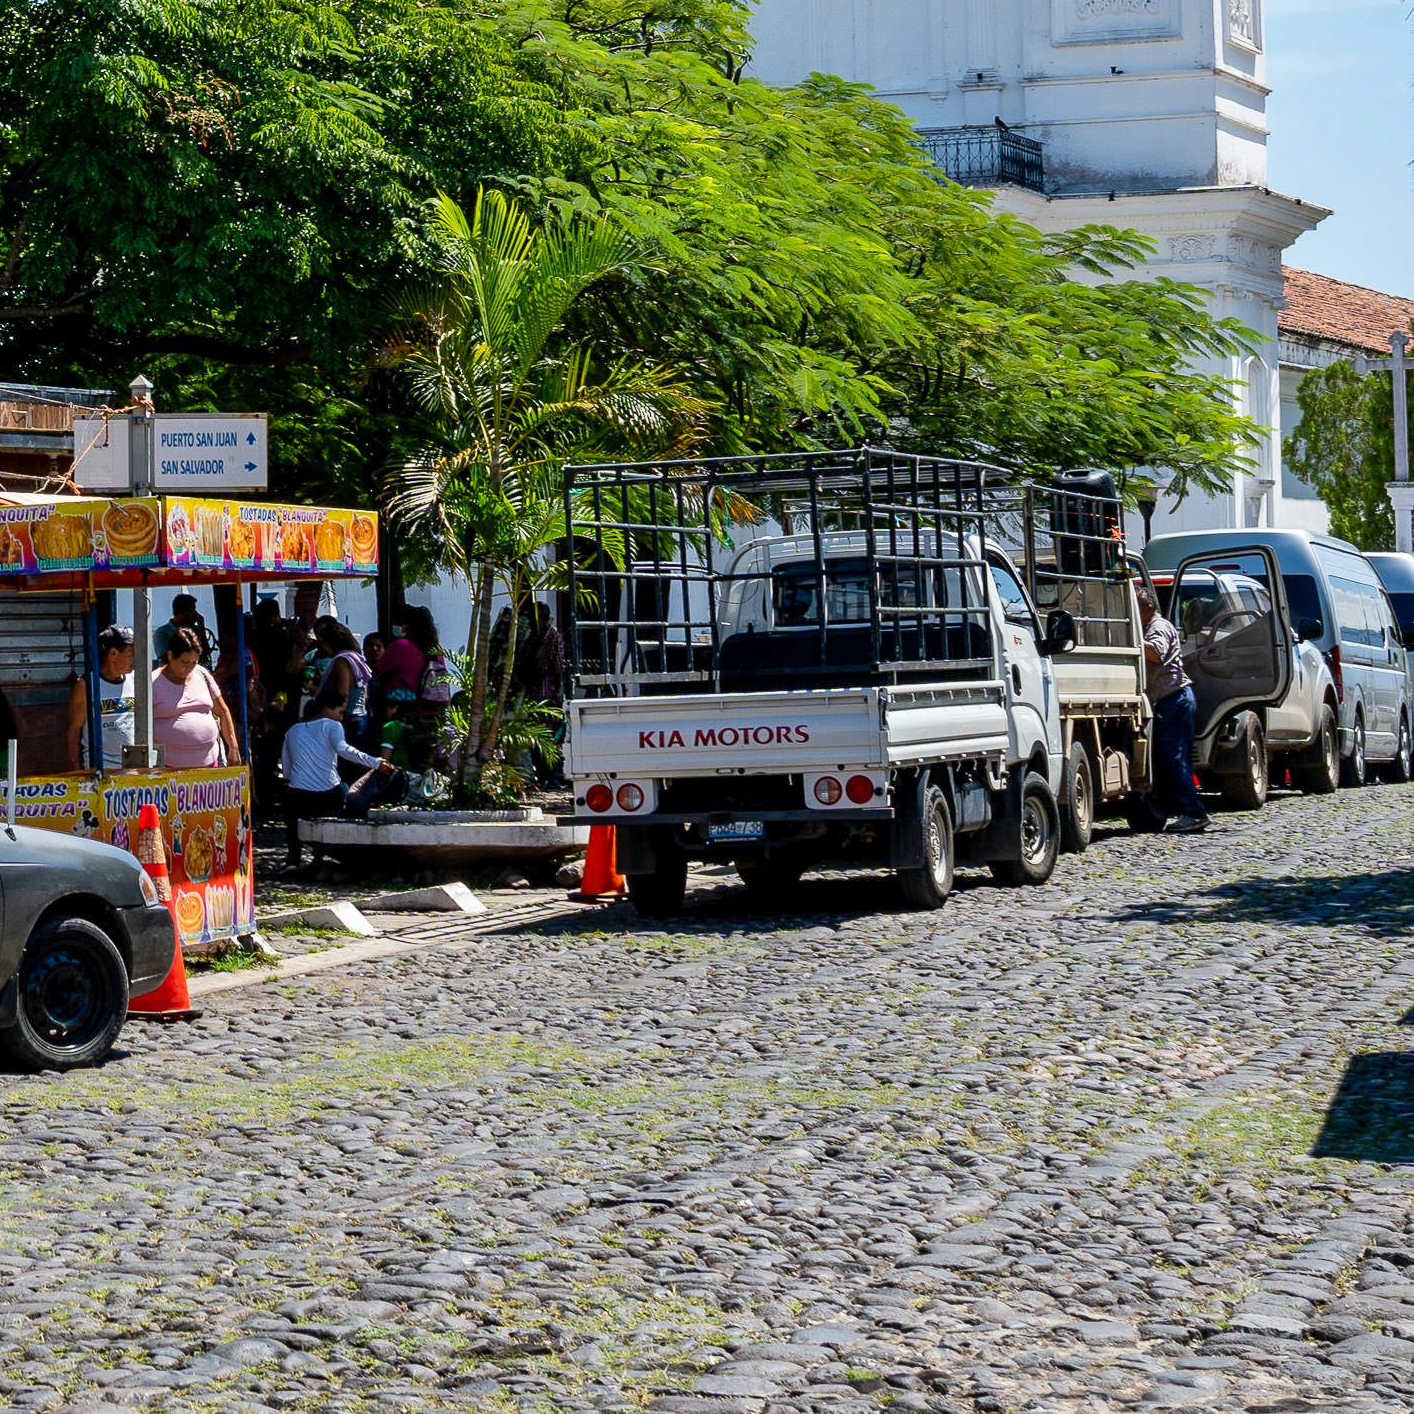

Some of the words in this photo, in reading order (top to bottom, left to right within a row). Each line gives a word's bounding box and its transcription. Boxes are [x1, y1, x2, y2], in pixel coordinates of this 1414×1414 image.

[161, 433, 194, 447] PUERTO
[196, 433, 213, 447] SAN
[215, 432, 237, 446] JUAN
[161, 460, 178, 475] SAN
[180, 460, 224, 474] SALVADOR
[239, 506, 277, 523] TOSTADAS
[639, 731, 685, 748] KIA
[694, 725, 810, 747] MOTORS
